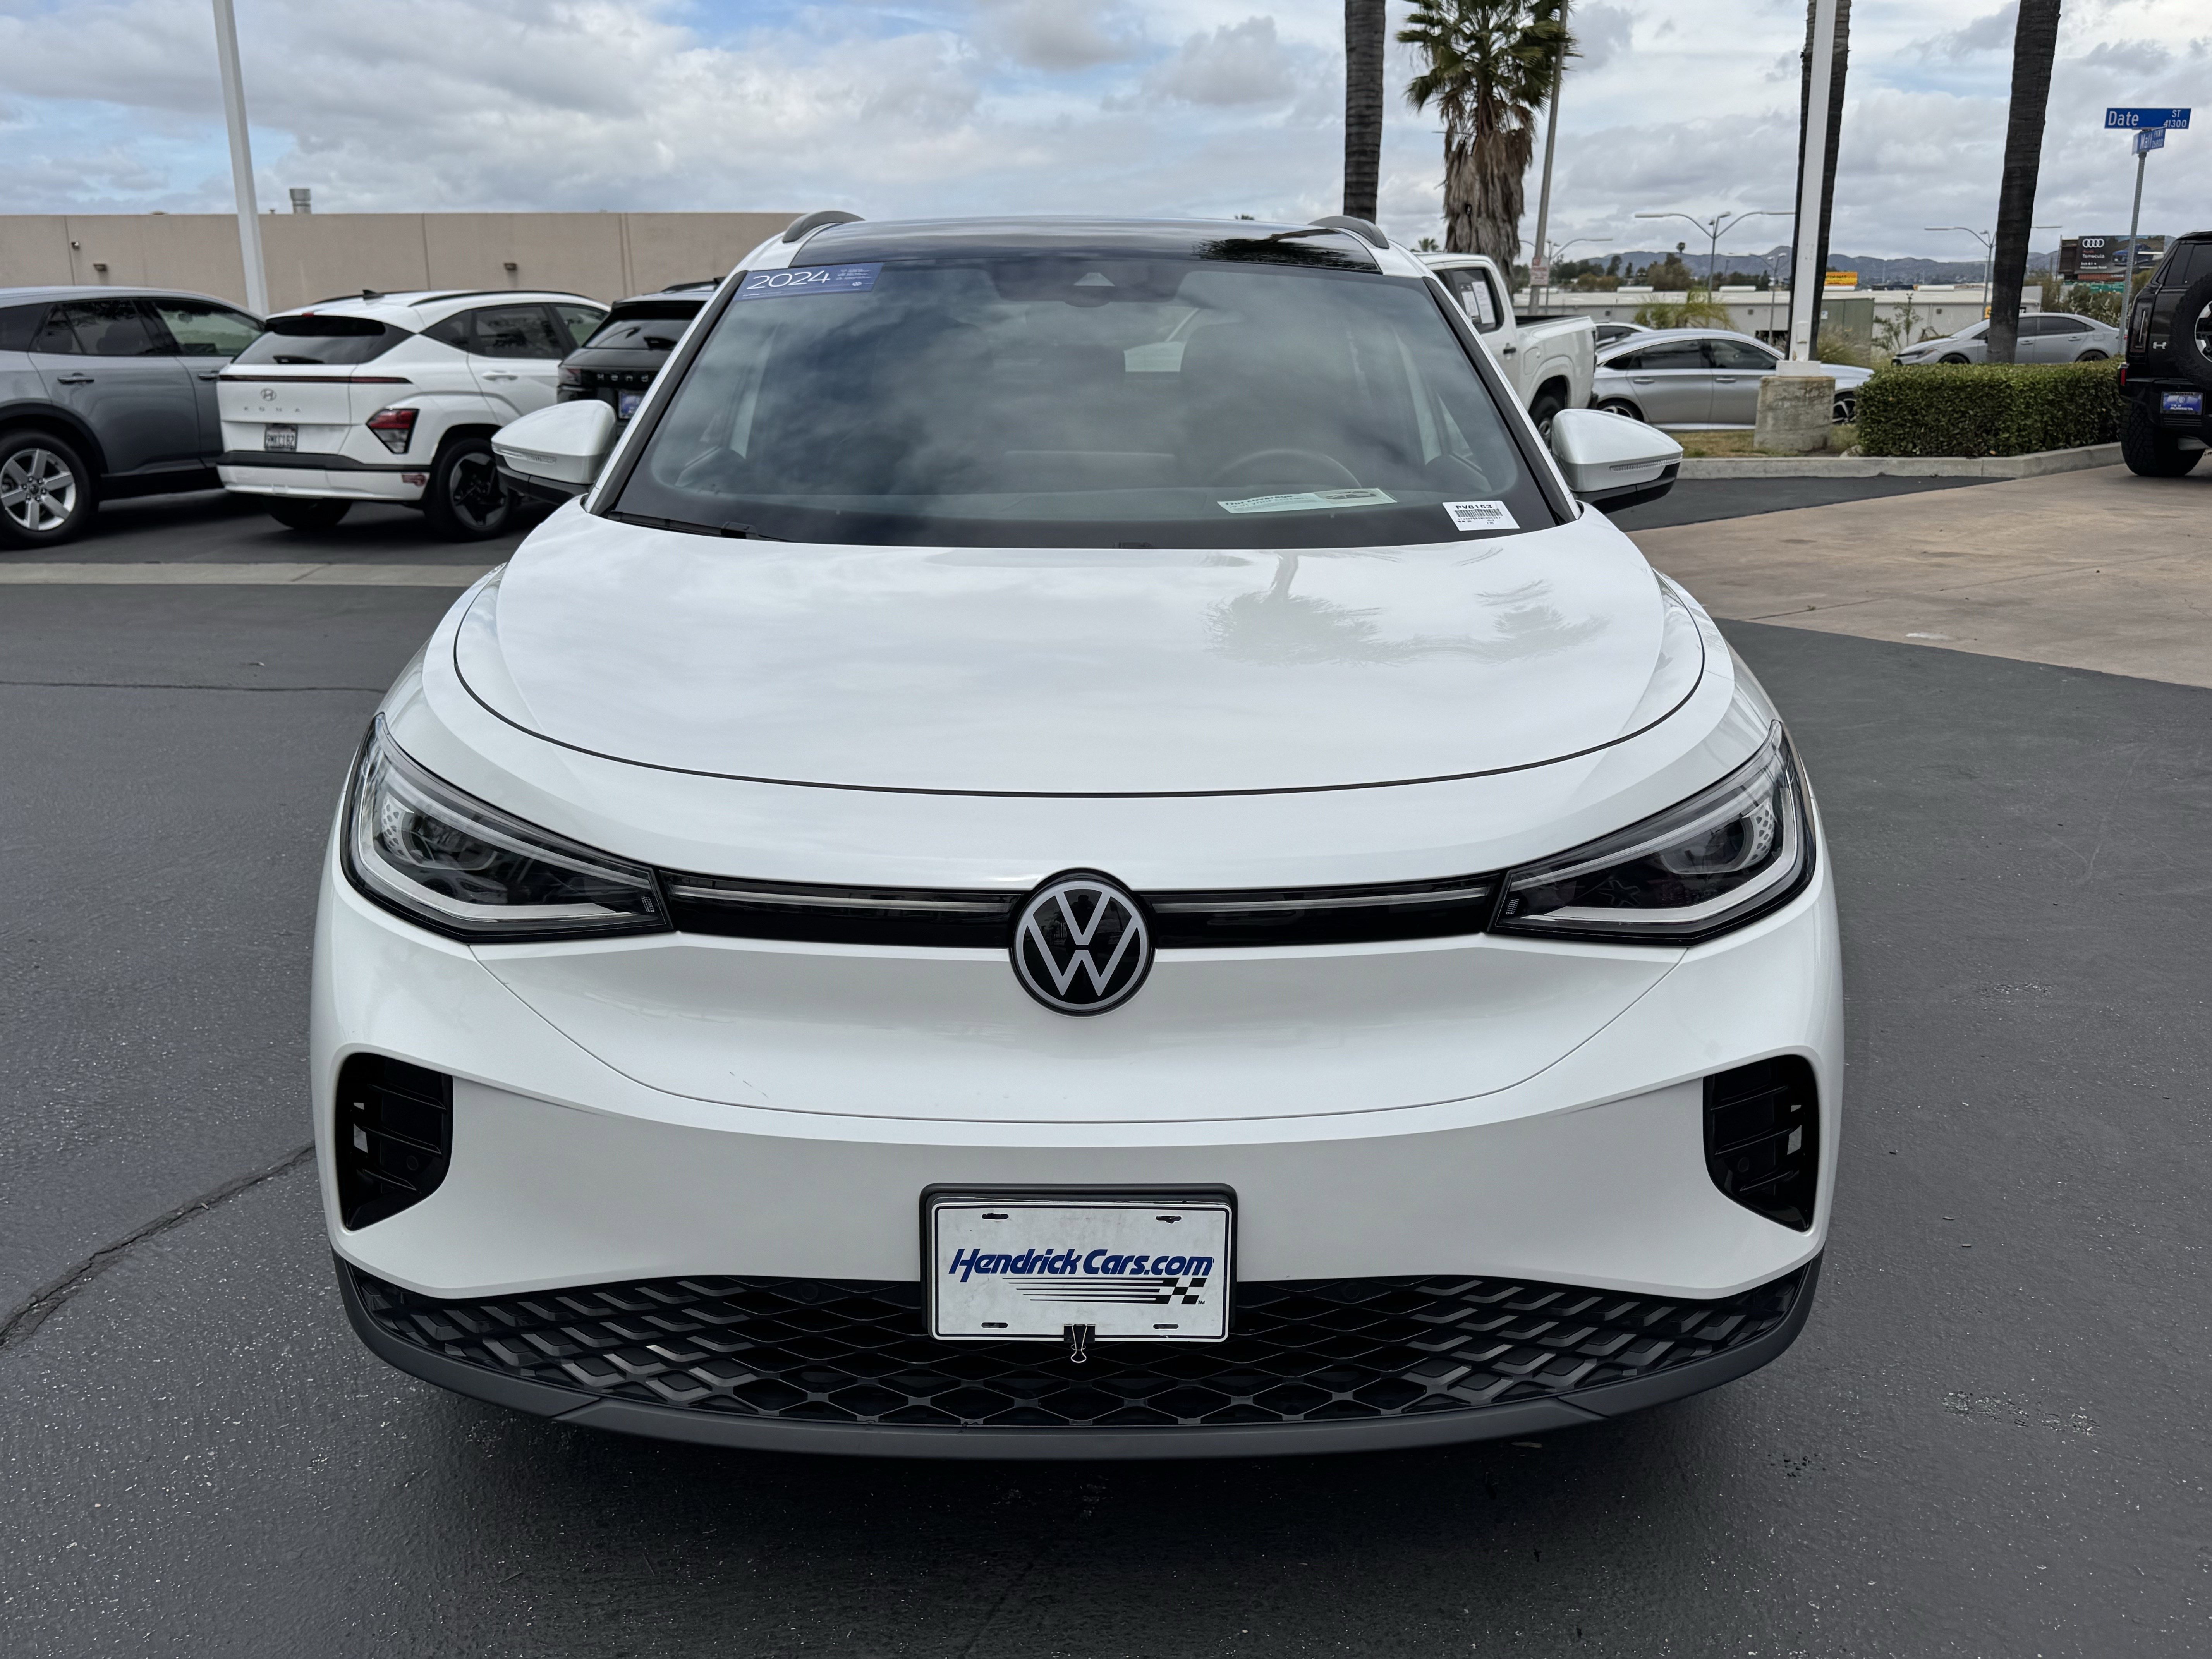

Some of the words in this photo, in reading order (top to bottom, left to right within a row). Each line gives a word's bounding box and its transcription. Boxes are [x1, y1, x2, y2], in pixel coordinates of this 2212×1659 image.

[2108, 110, 2139, 126] Date
[2172, 110, 2181, 118] ST
[746, 270, 831, 290] 2024
